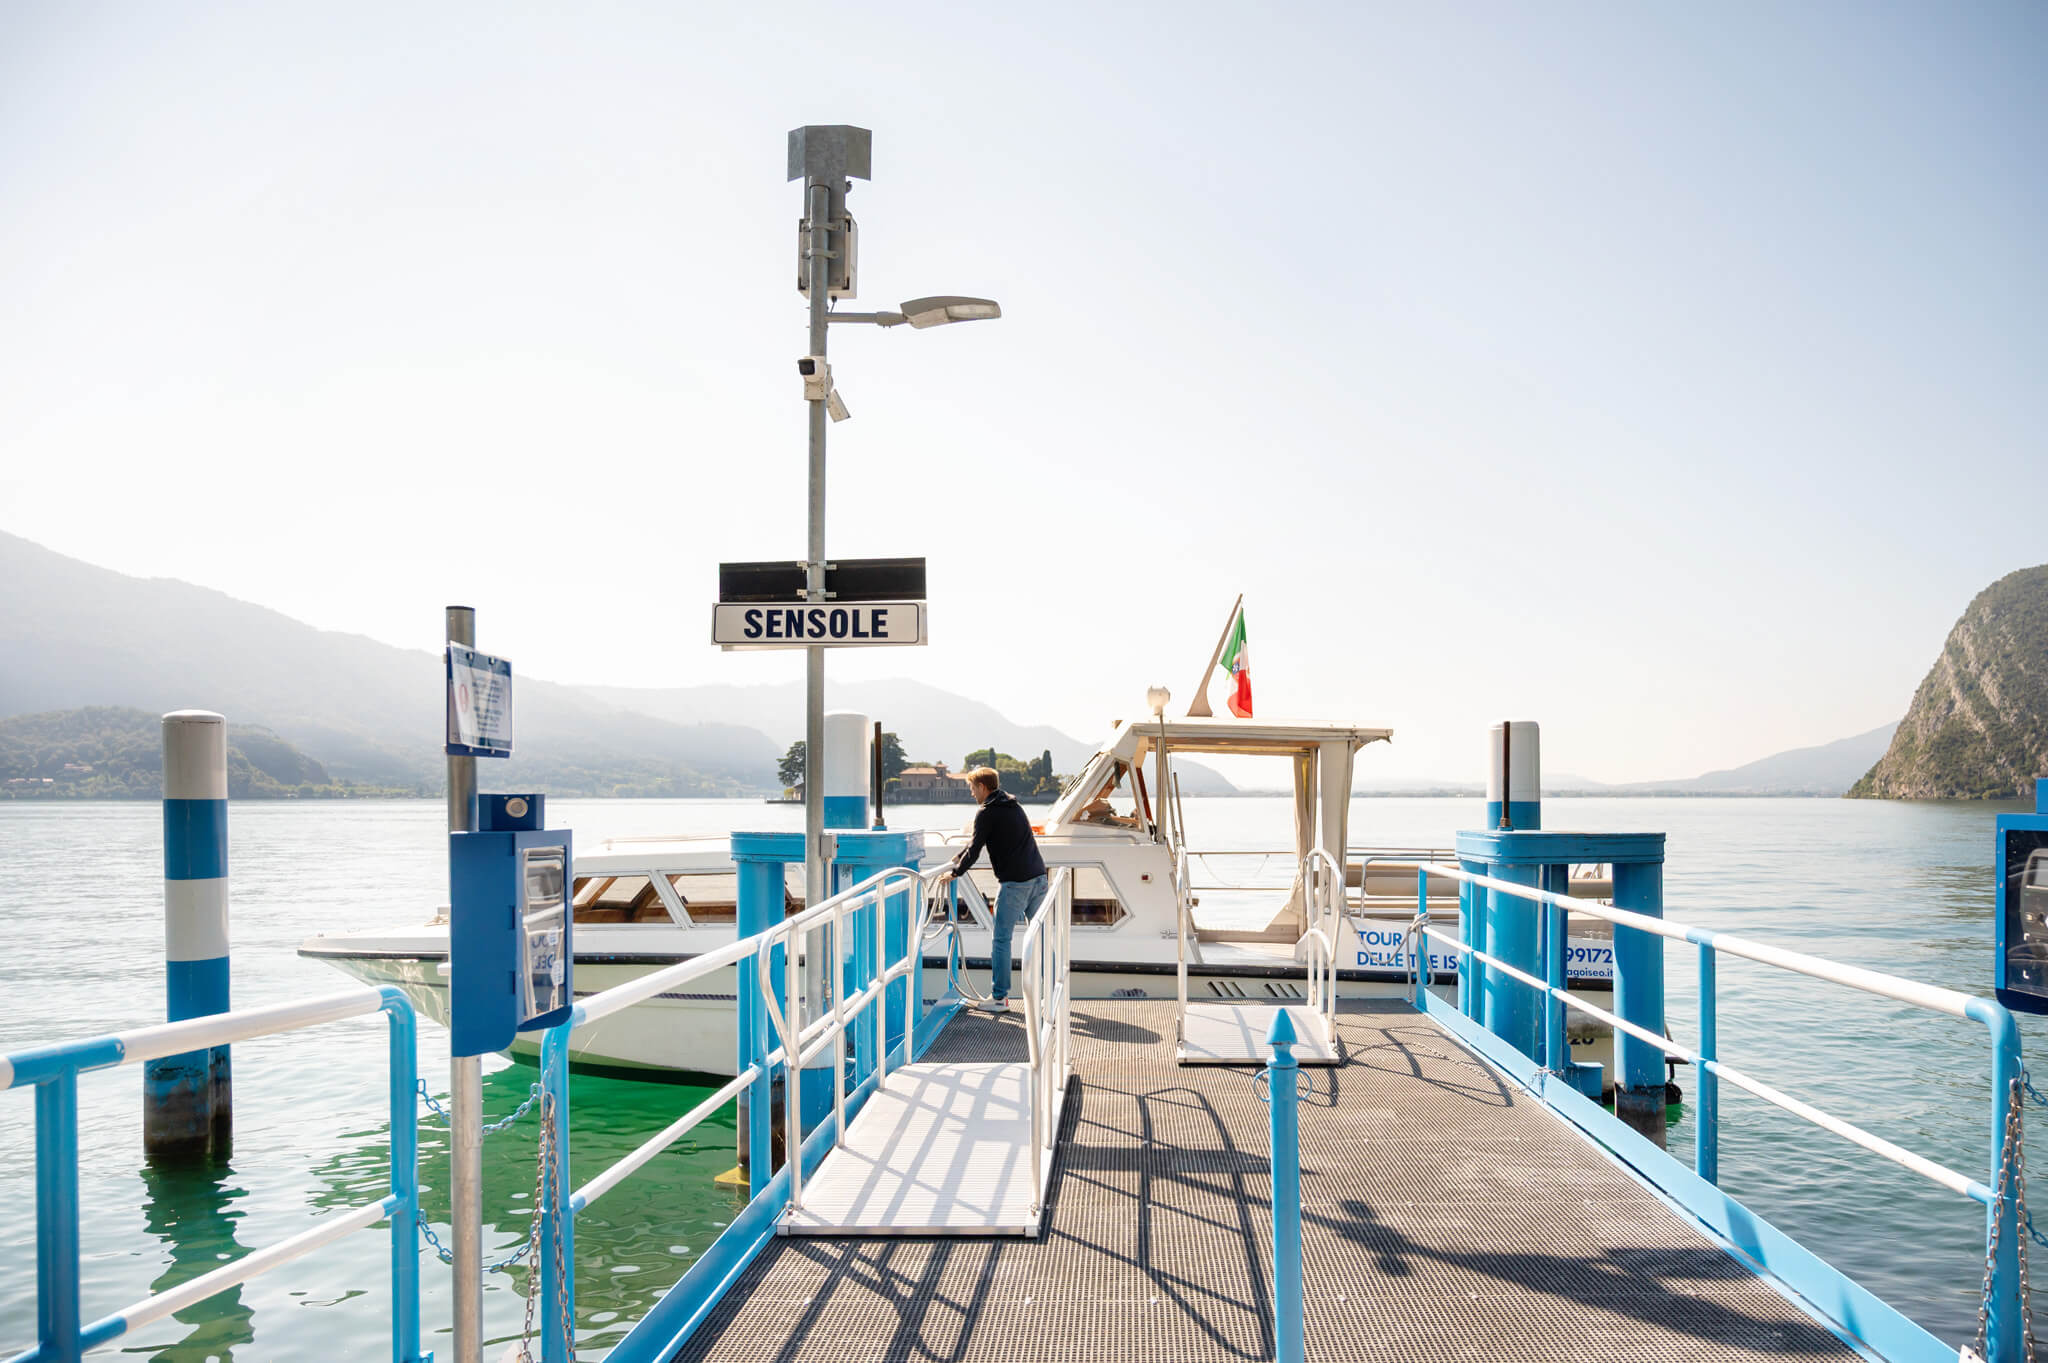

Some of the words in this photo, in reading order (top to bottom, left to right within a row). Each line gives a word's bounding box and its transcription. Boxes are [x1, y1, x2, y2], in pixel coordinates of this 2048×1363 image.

[744, 609, 888, 638] SENSOLE
[1357, 931, 1402, 946] TOUR
[1357, 951, 1404, 967] DELLE
[1409, 954, 1438, 968] TE
